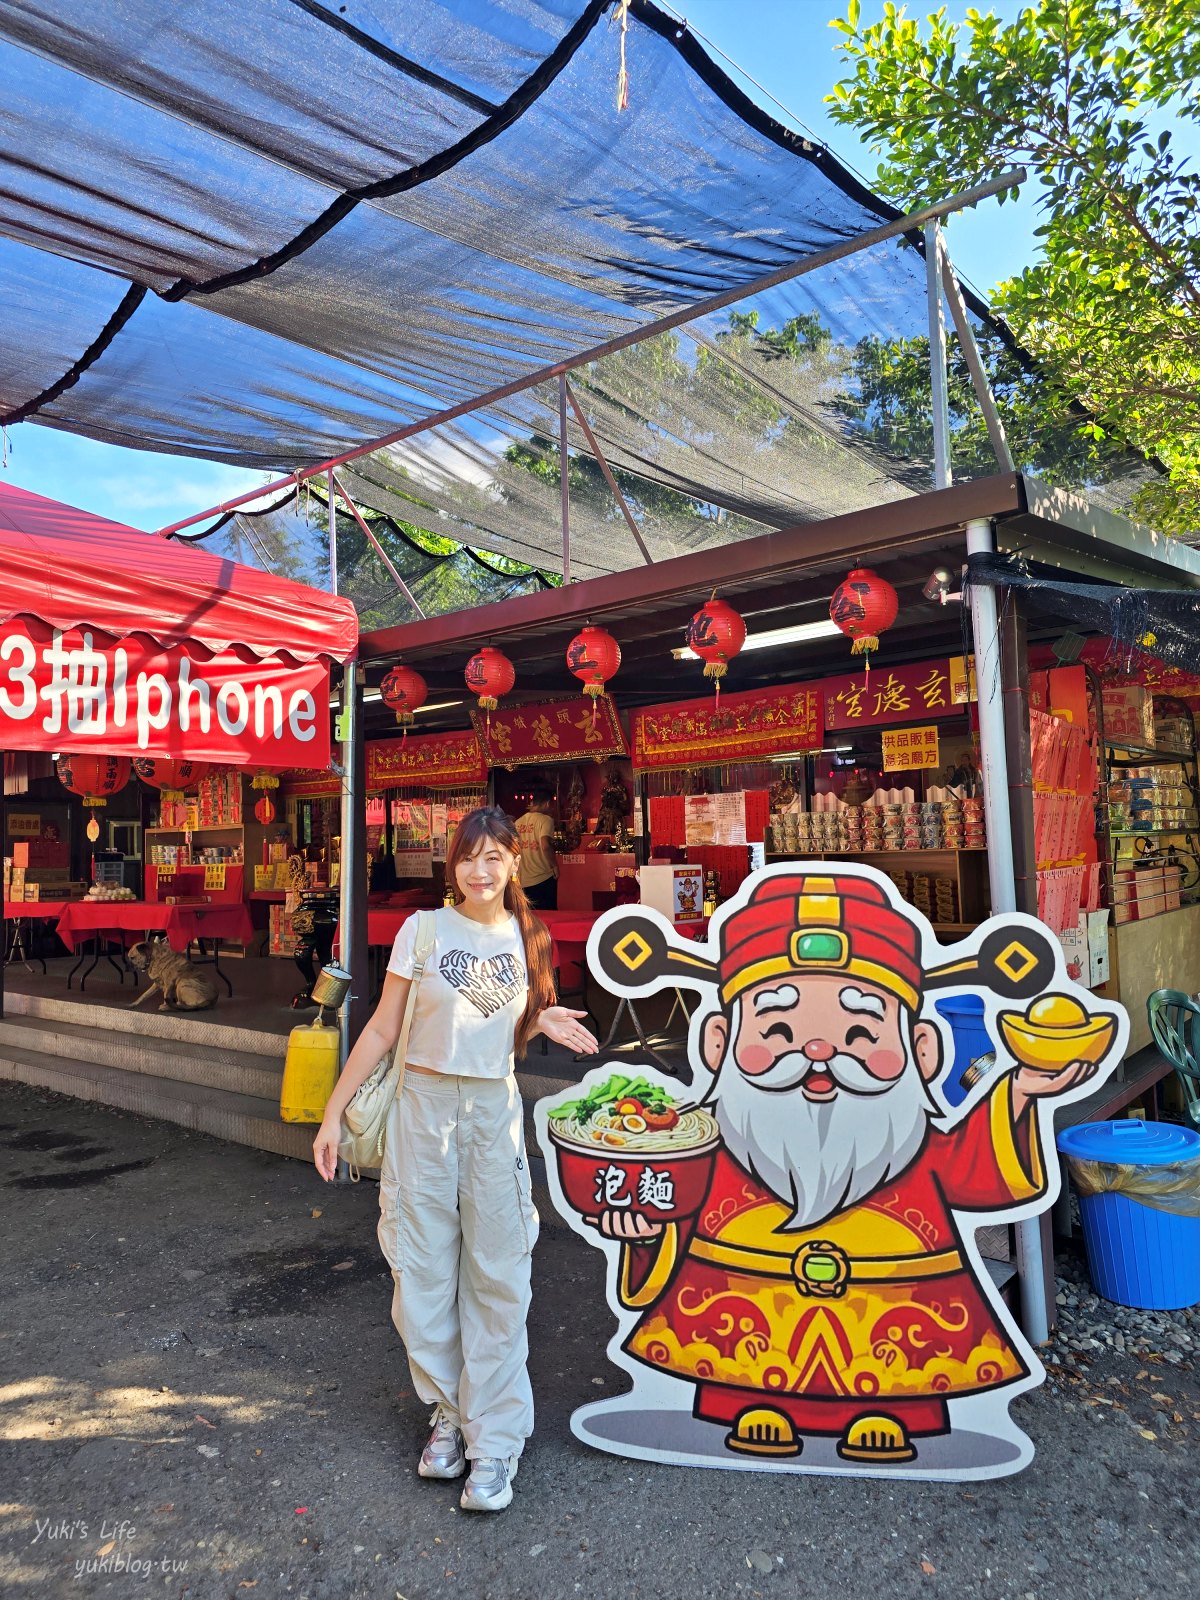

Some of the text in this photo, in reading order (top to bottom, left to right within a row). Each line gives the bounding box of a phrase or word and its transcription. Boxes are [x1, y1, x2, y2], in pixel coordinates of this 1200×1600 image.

[884, 731, 936, 748] 供品販售
[594, 1164, 675, 1210] 泡麵
